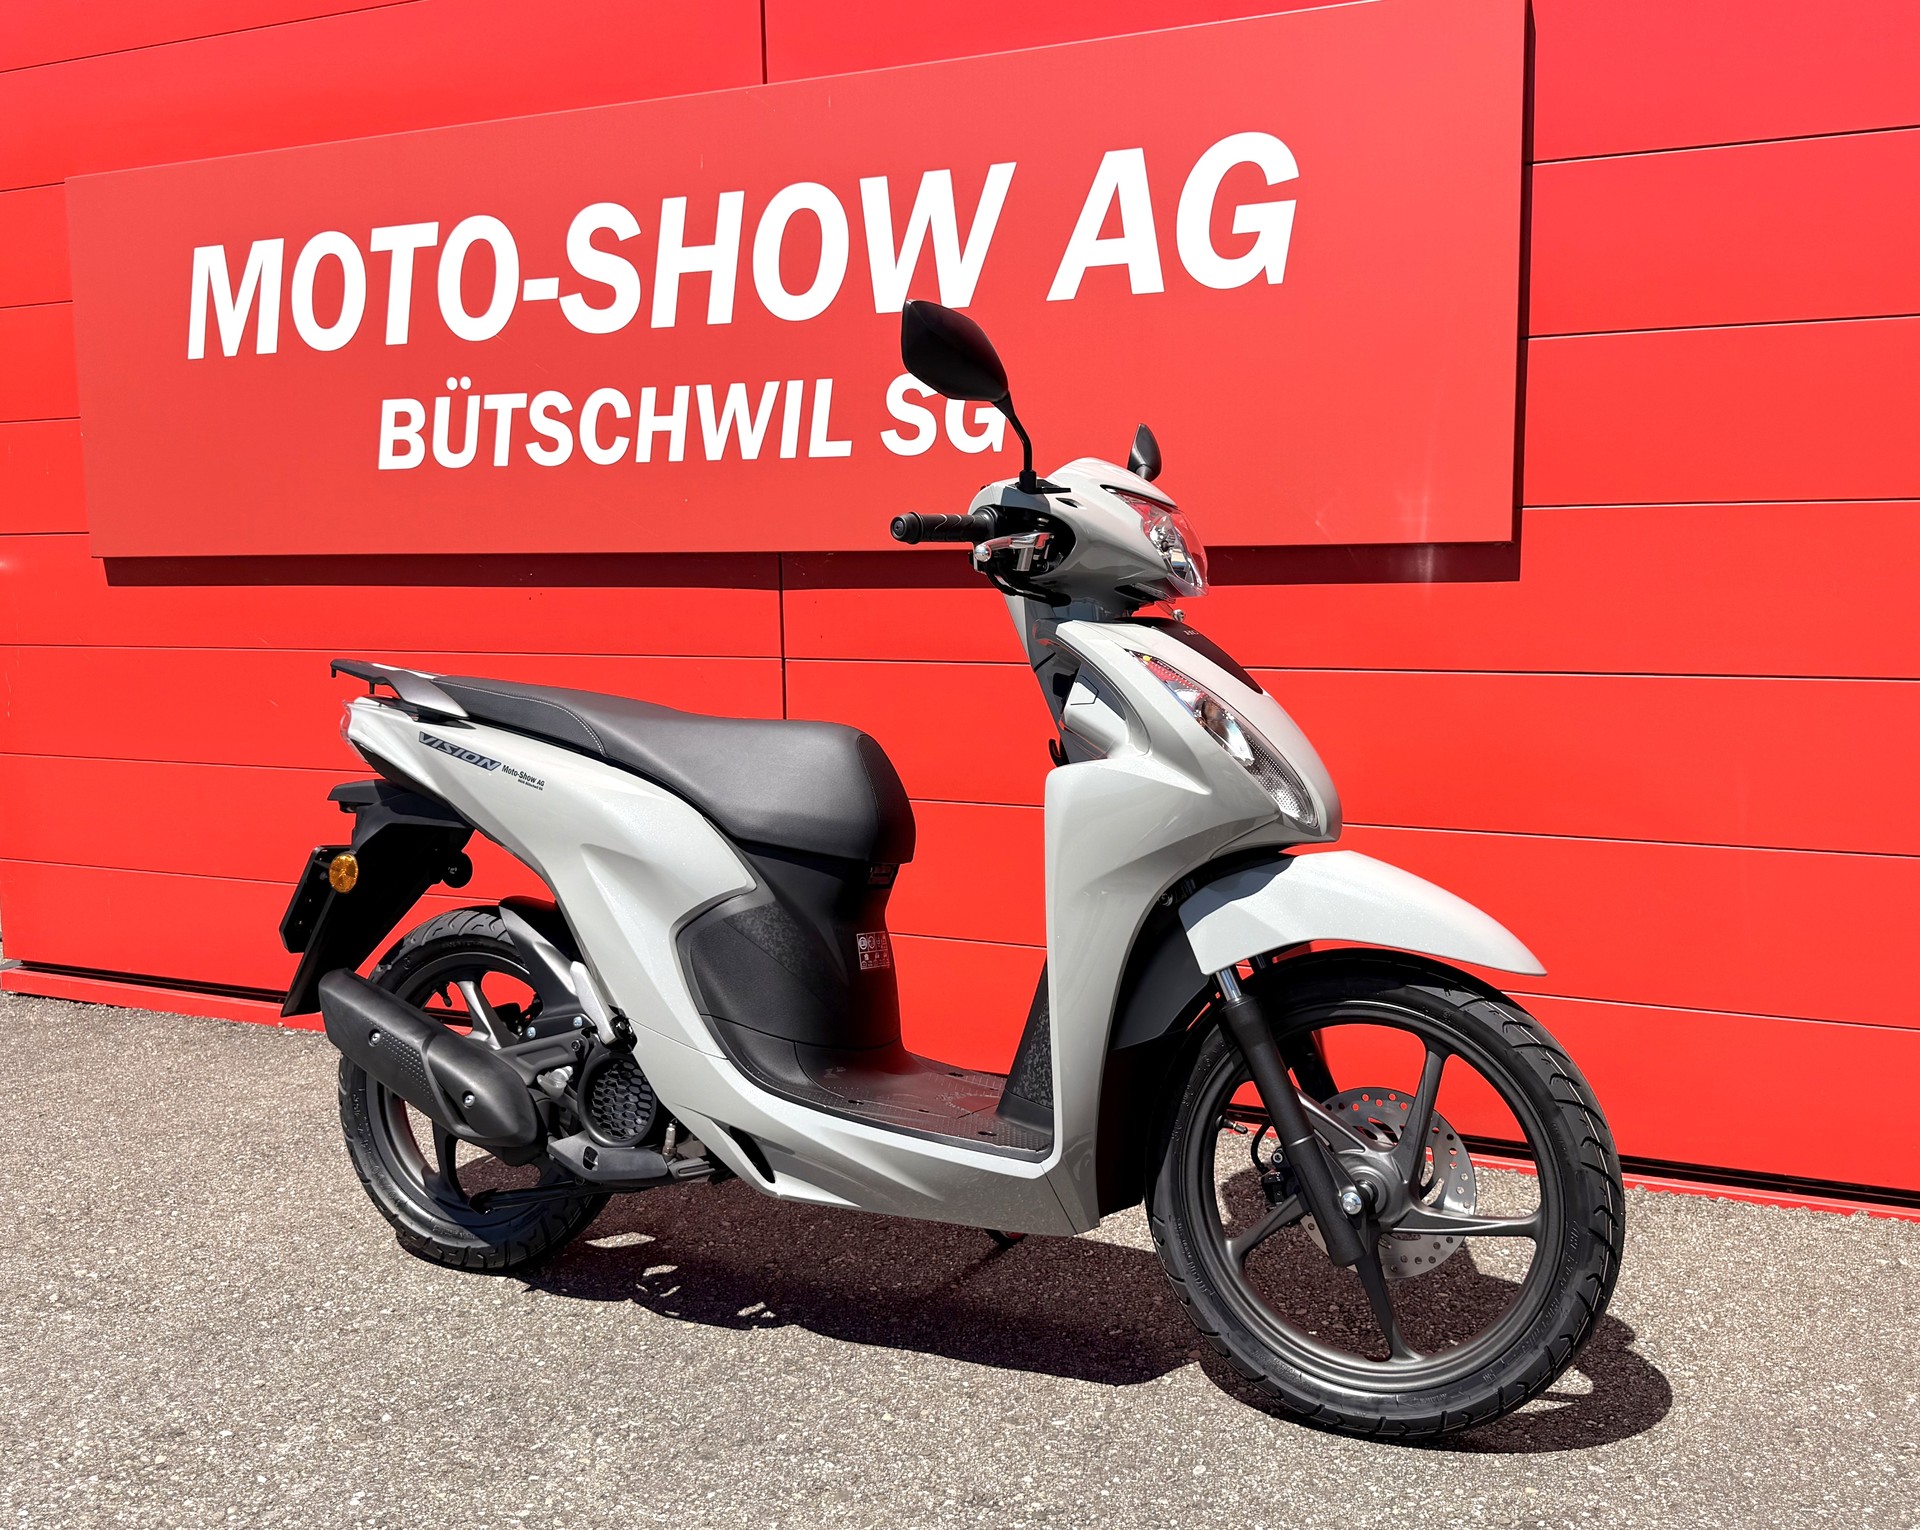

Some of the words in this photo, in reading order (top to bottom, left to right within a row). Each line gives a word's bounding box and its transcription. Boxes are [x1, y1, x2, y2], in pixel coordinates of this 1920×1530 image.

[187, 161, 1017, 360] MOTO-SHOW
[1046, 131, 1300, 302] AG
[378, 376, 853, 470] BÜTSCHWIL
[880, 372, 1008, 458] SG
[419, 731, 501, 771] VISION
[501, 764, 538, 783] Moto-Show
[537, 779, 545, 787] AG
